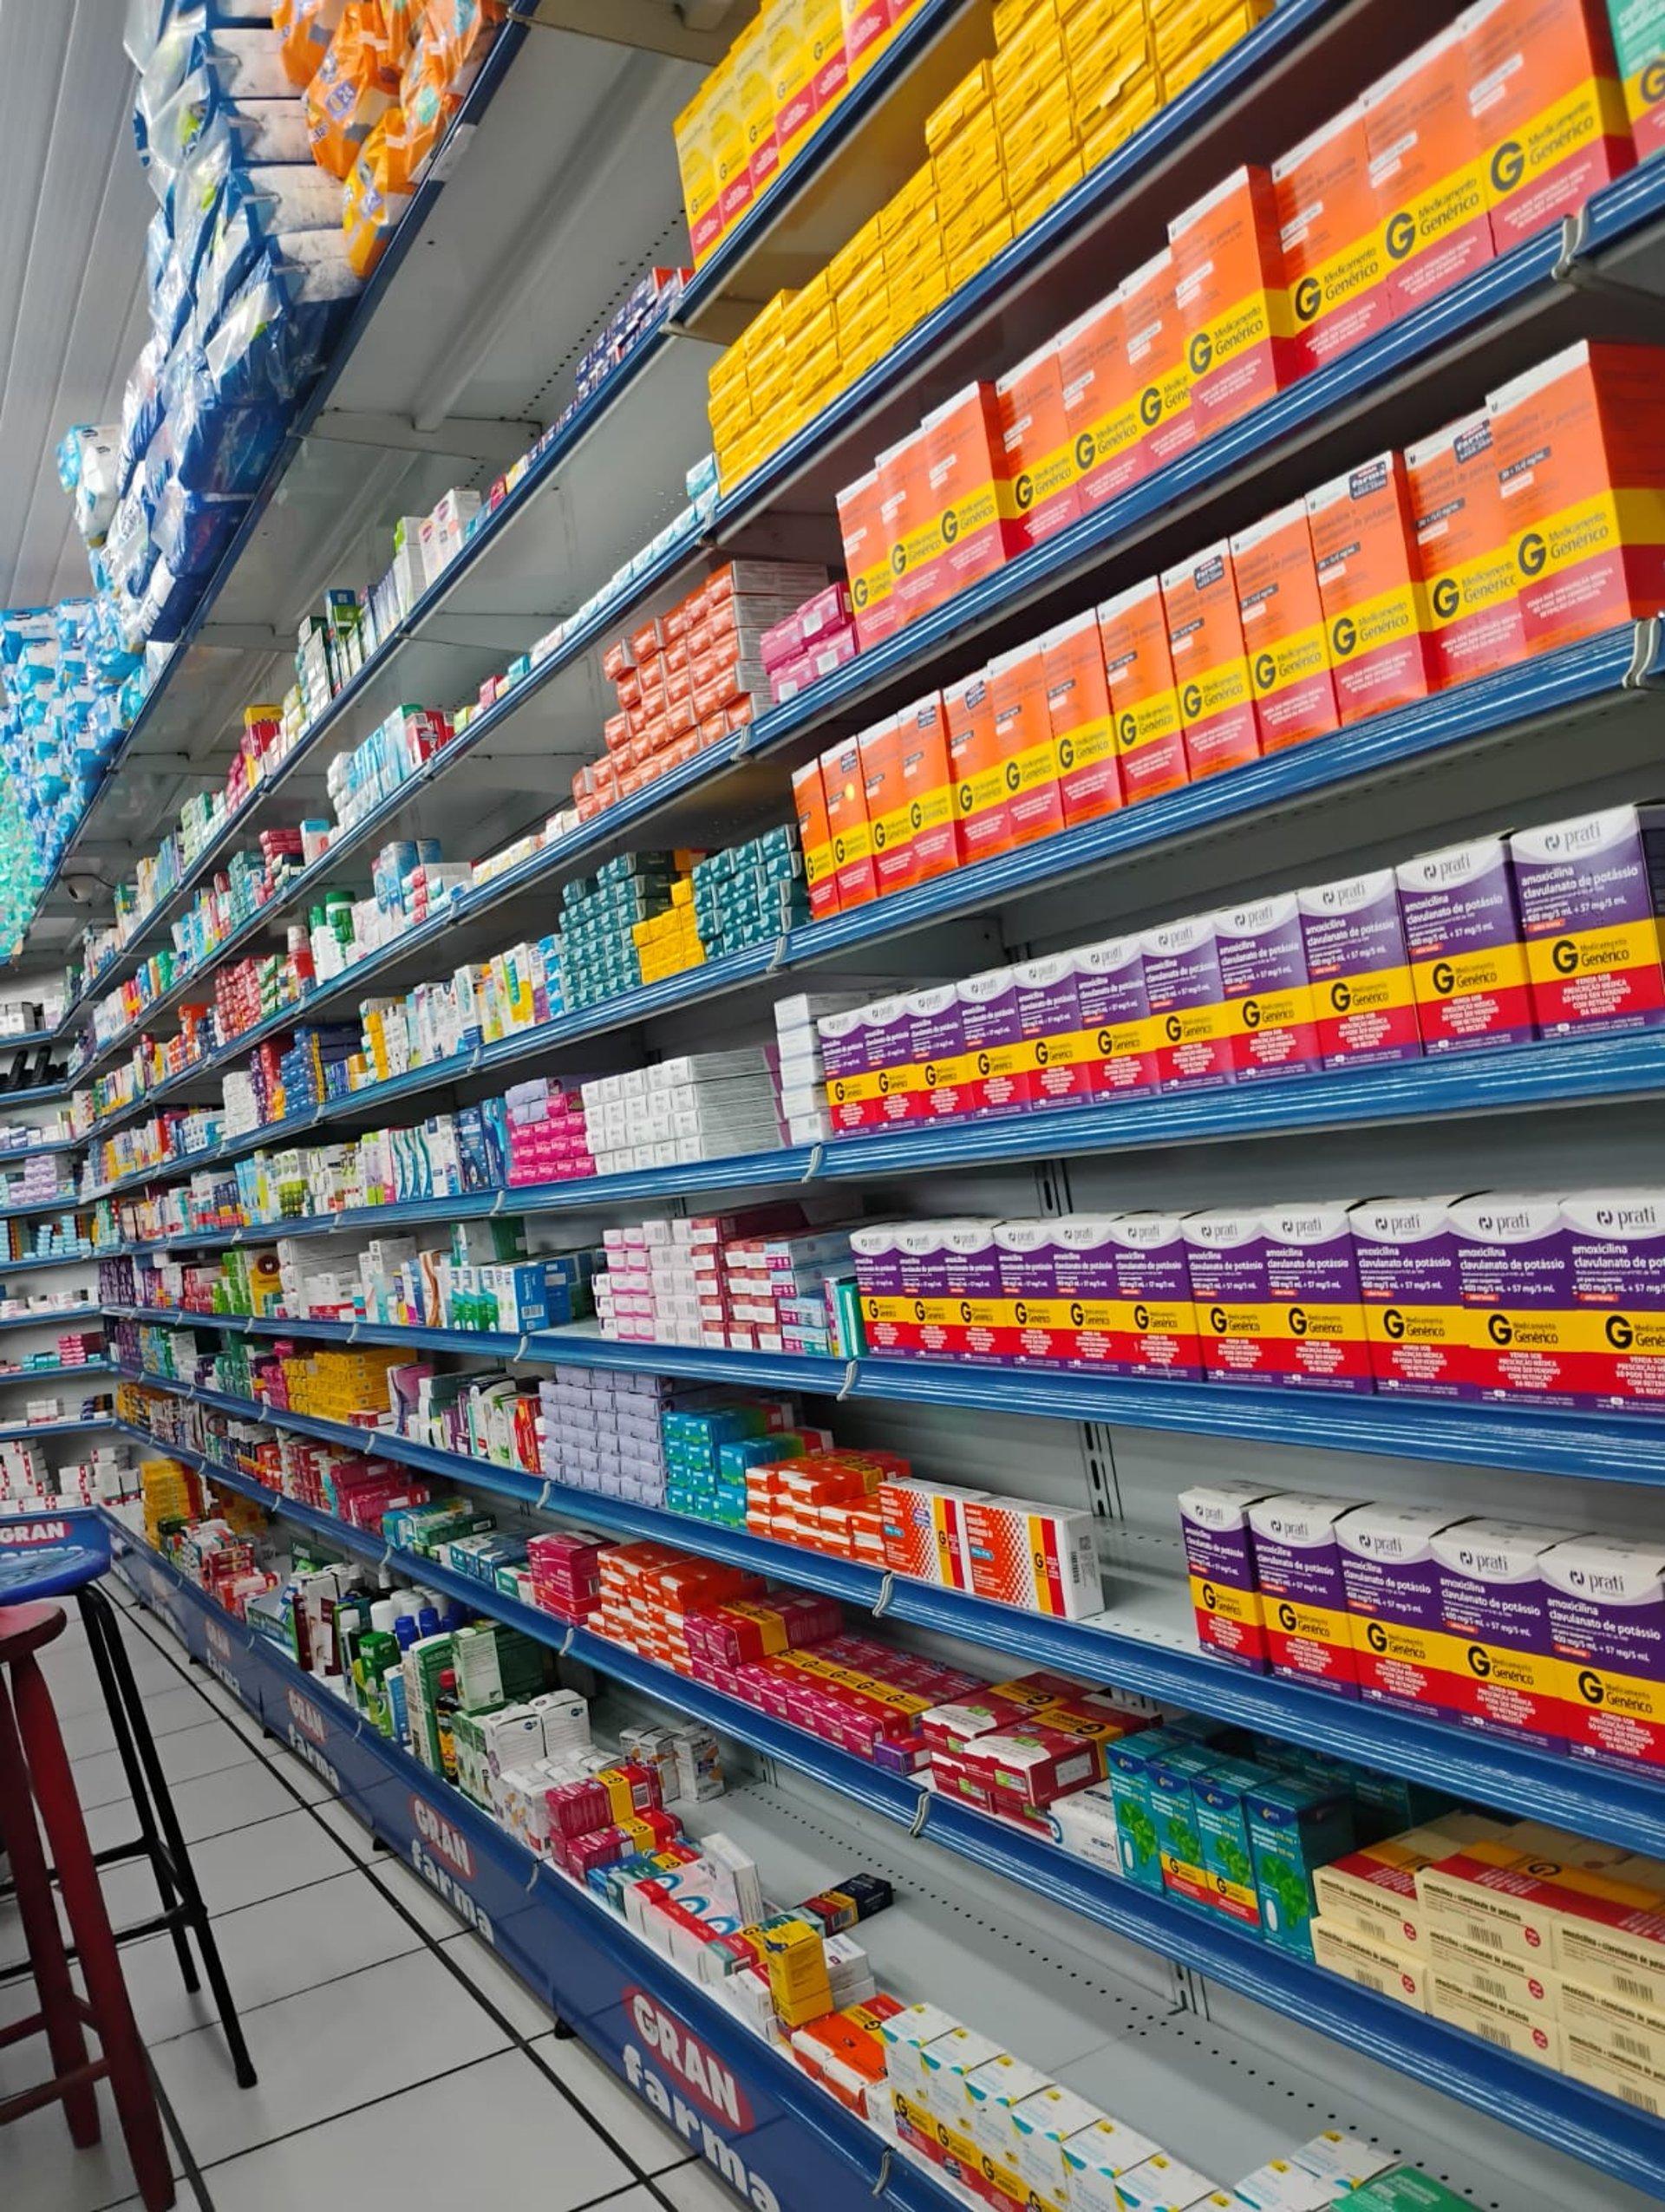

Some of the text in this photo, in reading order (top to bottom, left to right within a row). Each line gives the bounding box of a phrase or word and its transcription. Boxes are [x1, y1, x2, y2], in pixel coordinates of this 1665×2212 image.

[1529, 115, 1594, 165] Genérico
[1492, 141, 1524, 191] G
[1420, 192, 1479, 235] Genérico
[1387, 212, 1415, 258] G
[1324, 261, 1378, 300] Genérico
[1295, 277, 1321, 321] G
[1215, 318, 1263, 354] Genérico
[1189, 334, 1212, 374] G
[1140, 388, 1162, 426] G
[1076, 434, 1094, 470] G
[1015, 475, 1033, 508] G
[1518, 533, 1546, 576] G
[1550, 525, 1609, 559] Genérico
[1433, 579, 1459, 617] G
[1333, 617, 1356, 656] G
[1360, 612, 1409, 641] Genérico
[1256, 653, 1276, 689] G
[1278, 650, 1322, 676] Genérico
[1184, 685, 1202, 717] G
[1564, 821, 1600, 852] prati
[1440, 854, 1470, 880] prati
[1522, 866, 1574, 885] amoxicilina
[1336, 883, 1365, 905] prati
[1524, 865, 1638, 899] clavulanato de potássio
[1249, 907, 1272, 928] prati
[1453, 903, 1465, 914] de
[1348, 927, 1360, 937] de
[1552, 939, 1578, 974] G
[1581, 949, 1629, 967] Genérico
[1433, 962, 1454, 995] G
[1457, 970, 1497, 988] Genérico
[1331, 982, 1350, 1012] G
[1353, 991, 1388, 1005] Genérico
[1243, 1000, 1260, 1028] G
[1262, 1008, 1295, 1022] Genérico
[1166, 1016, 1182, 1041] G
[1296, 1218, 1322, 1237] prati
[1391, 1214, 1420, 1235] prati
[1497, 1211, 1530, 1236] prati
[1617, 1206, 1655, 1230] prati
[1403, 1258, 1413, 1268] de
[1459, 1247, 1506, 1257] amoxicilina
[1572, 1243, 1628, 1255] amoxicilina
[1574, 1256, 1631, 1269] clavulanato
[1632, 1256, 1646, 1268] de
[1460, 1258, 1564, 1271] clavulanato de potássio
[1211, 1307, 1227, 1334] G
[1289, 1307, 1308, 1335] G
[1309, 1321, 1343, 1334] Genérico
[1383, 1308, 1405, 1339] G
[1406, 1324, 1446, 1337] Genérico
[1488, 1314, 1512, 1345] G
[1605, 1315, 1633, 1349] G
[1514, 1329, 1558, 1343] Genérico
[1, 1522, 65, 1543] GRAN
[1285, 1521, 1308, 1537] prati
[1374, 1538, 1402, 1553] prati
[1477, 1558, 1508, 1576] prati
[1385, 1578, 1395, 1589] de
[1440, 1576, 1485, 1594] amoxicilina
[1589, 1575, 1624, 1593] prati
[1441, 1589, 1541, 1617] clavulanato de potássio
[1547, 1597, 1599, 1615] amoxicilina
[1278, 1604, 1297, 1631] G
[1549, 1610, 1661, 1641] clavulanato de potássio
[1367, 1621, 1388, 1652] G
[1388, 1642, 1426, 1660] Genérico
[1467, 1646, 1492, 1677] G
[1492, 1666, 1534, 1685] Genérico
[1578, 1670, 1604, 1704] G
[288, 1690, 325, 1741] GRAN
[1607, 1692, 1653, 1713] Genérico
[288, 1725, 341, 1791] farma
[414, 1797, 472, 1877] GRAN
[411, 1842, 495, 1945] farma
[633, 1993, 741, 2127] GRAN
[623, 2044, 780, 2212] farma
